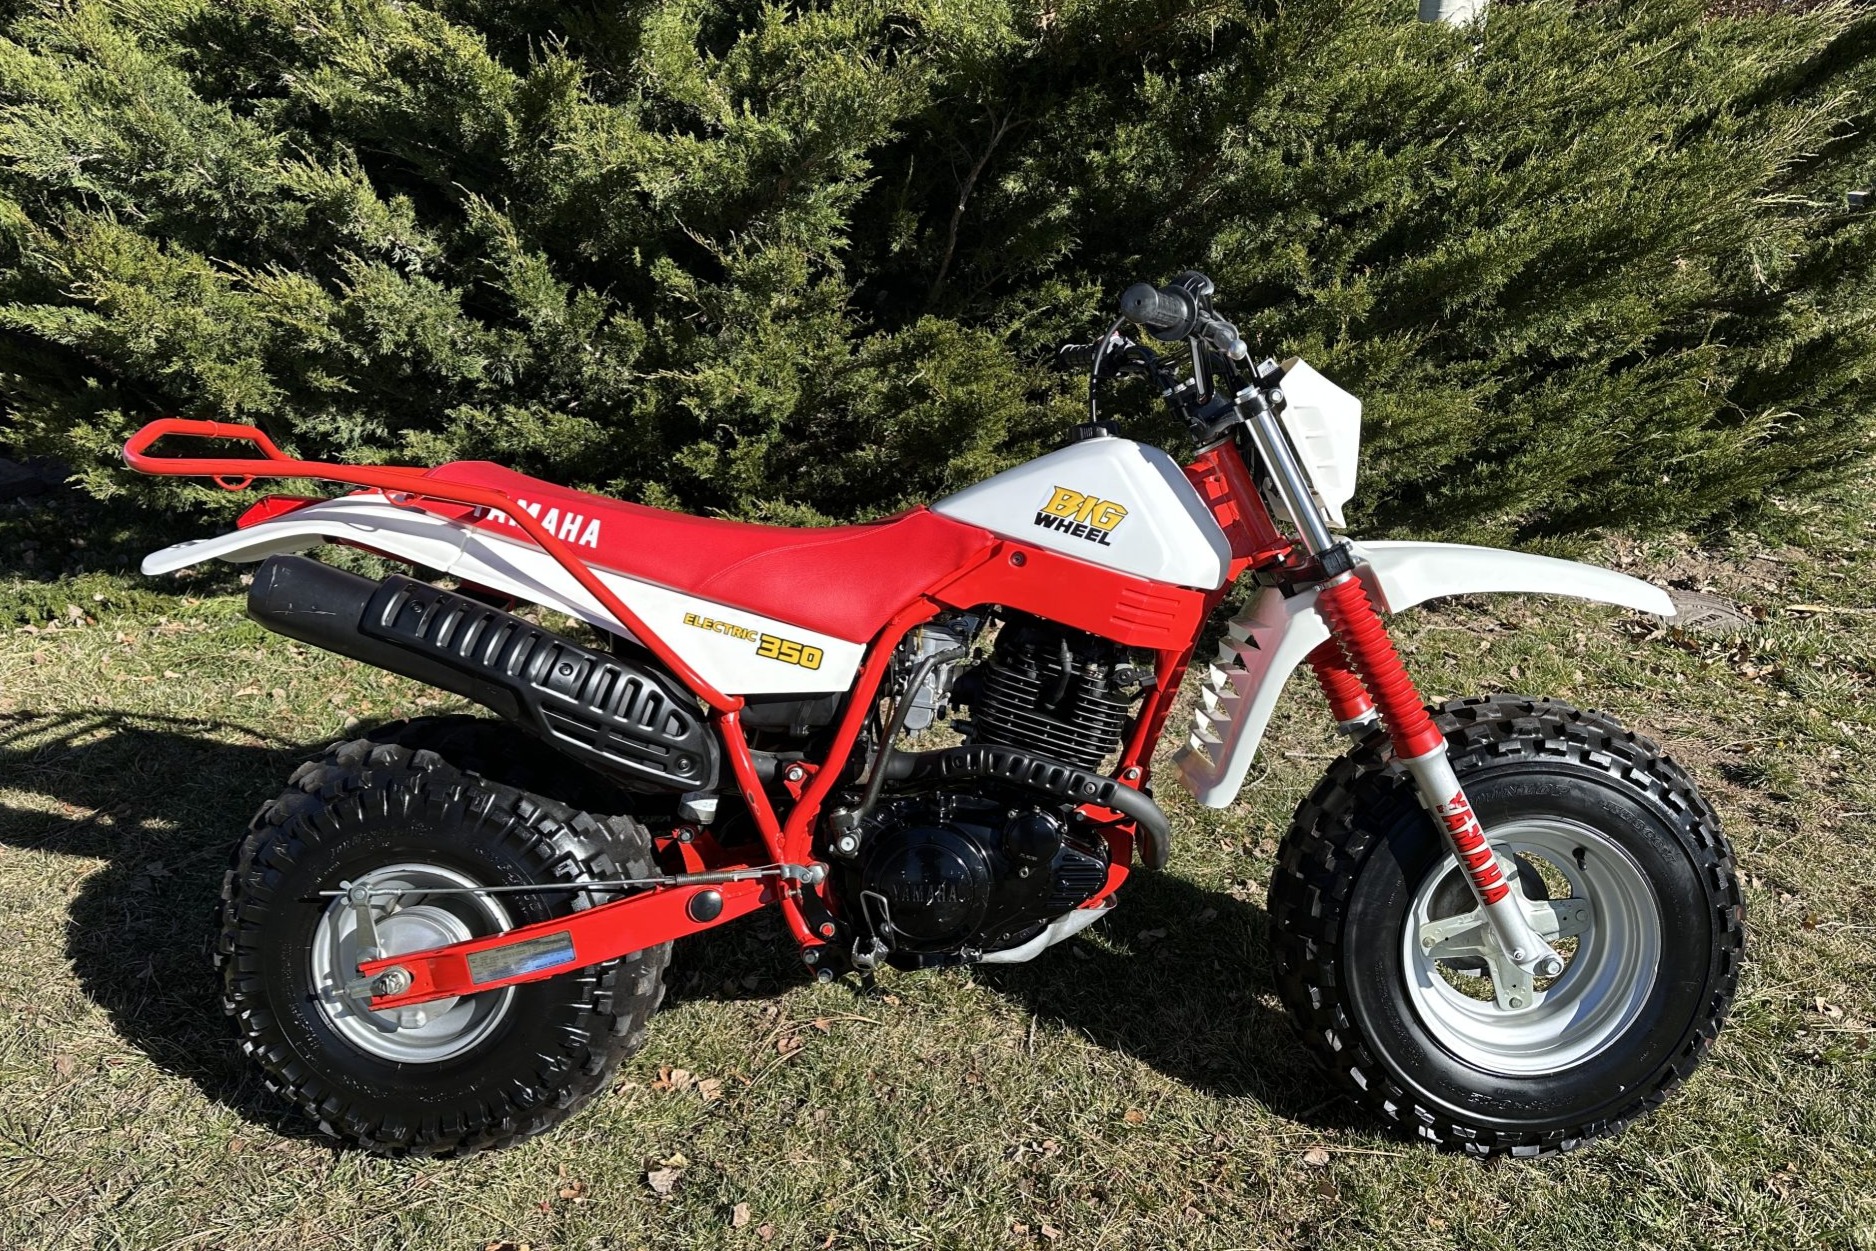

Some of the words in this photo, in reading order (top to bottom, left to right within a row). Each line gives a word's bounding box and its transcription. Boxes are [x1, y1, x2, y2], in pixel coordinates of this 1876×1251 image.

[1040, 485, 1128, 531] BIG
[1034, 512, 1111, 546] WHEEL
[683, 613, 758, 642] ELECTRIC
[756, 633, 824, 670] 350
[893, 884, 957, 902] YAMAHA
